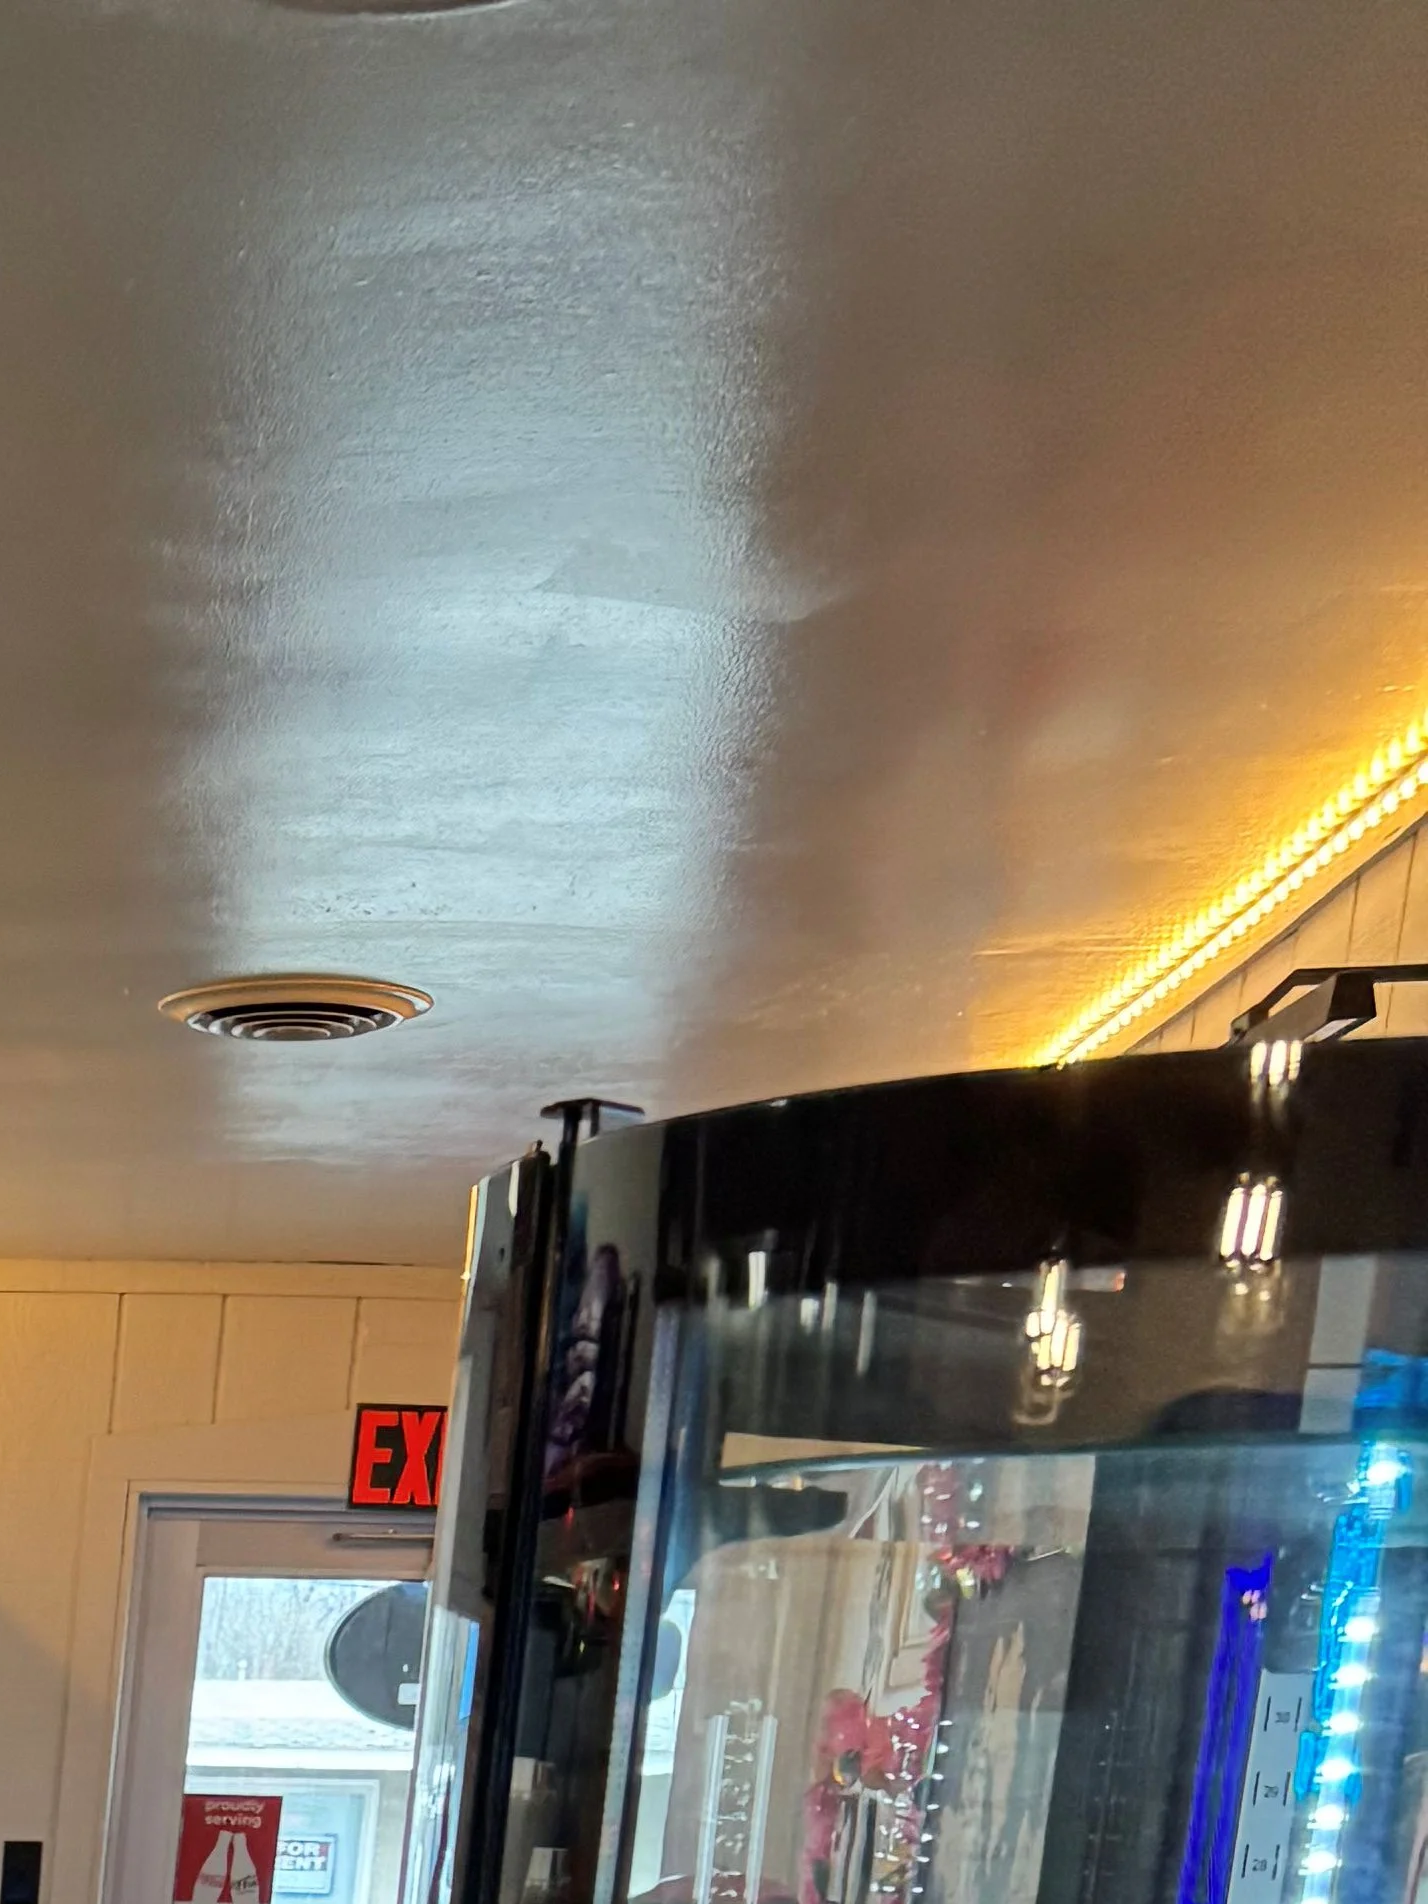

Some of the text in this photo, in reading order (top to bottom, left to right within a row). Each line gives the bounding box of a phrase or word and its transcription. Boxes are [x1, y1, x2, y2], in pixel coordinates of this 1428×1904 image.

[1263, 1784, 1280, 1798] 29
[204, 1800, 266, 1813] proudly
[204, 1815, 262, 1829] serving
[276, 1856, 327, 1871] ENT
[1252, 1858, 1268, 1872] 28
